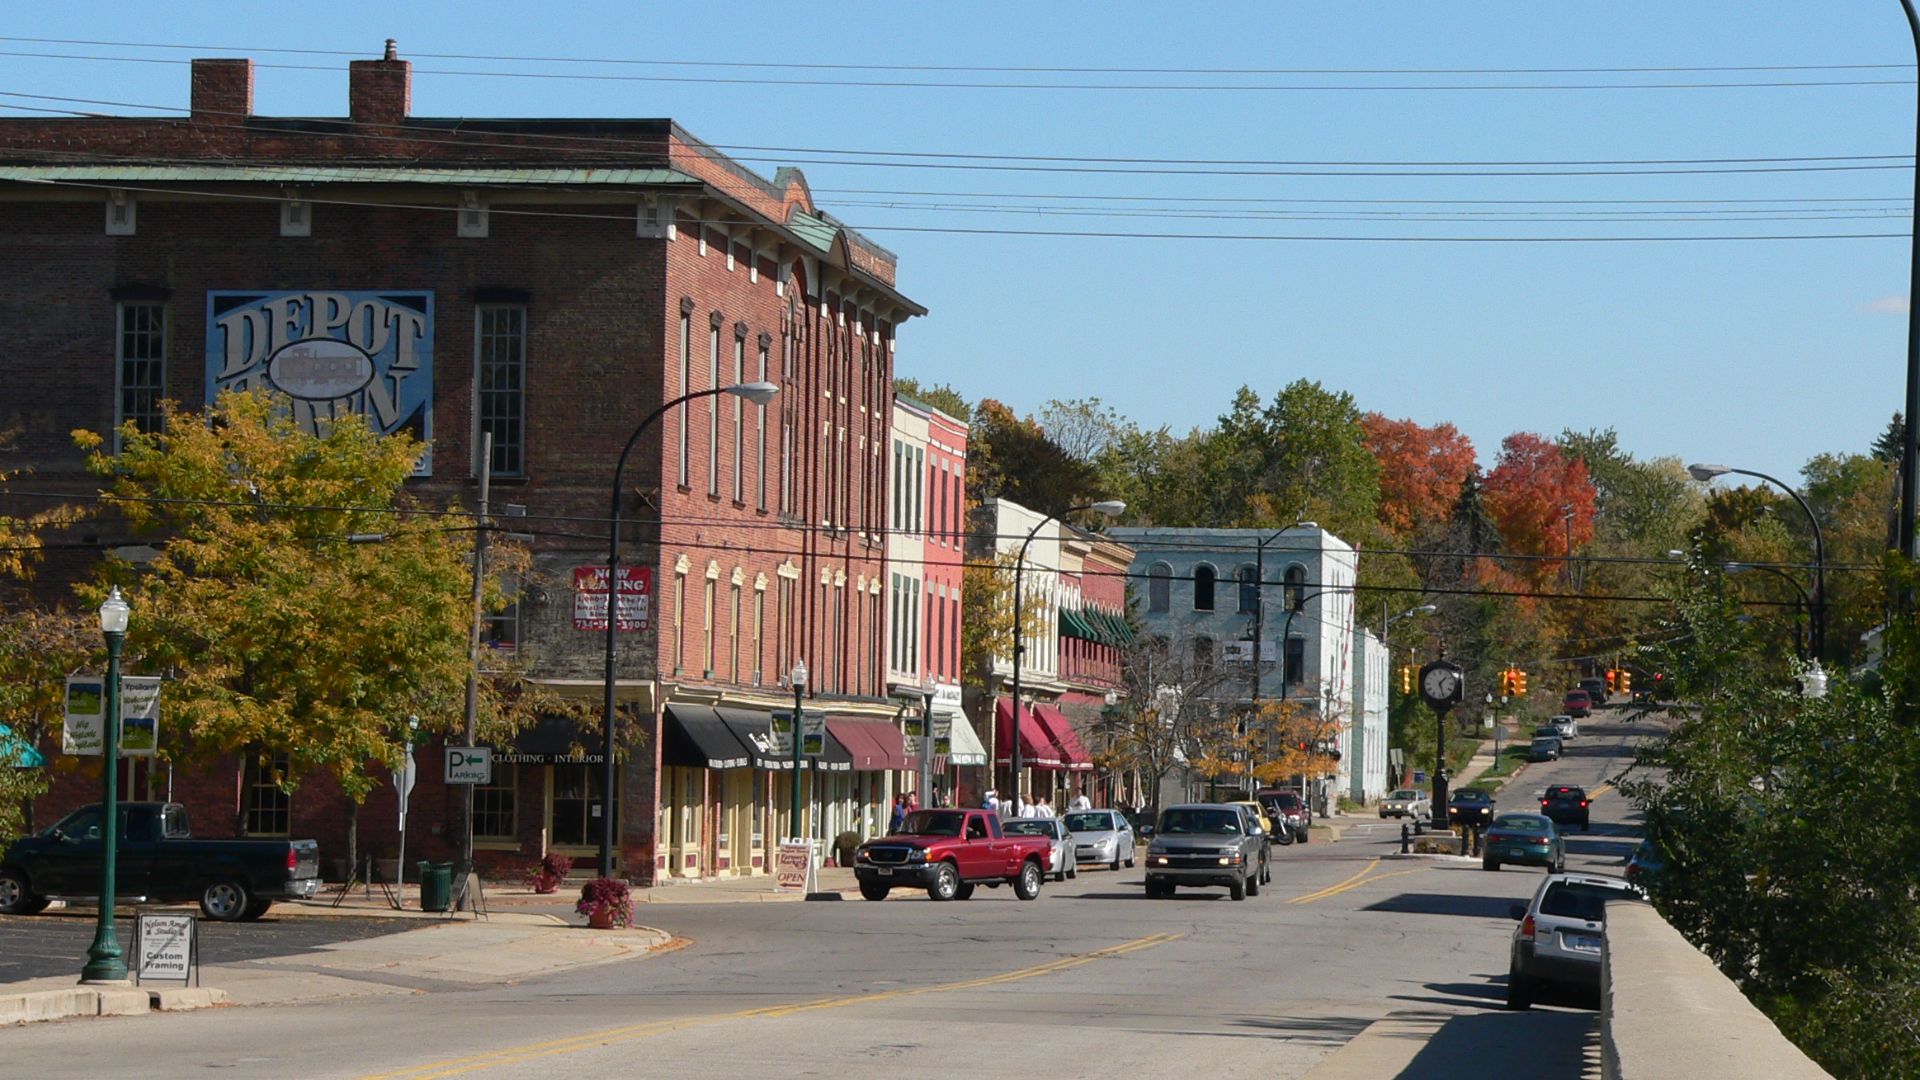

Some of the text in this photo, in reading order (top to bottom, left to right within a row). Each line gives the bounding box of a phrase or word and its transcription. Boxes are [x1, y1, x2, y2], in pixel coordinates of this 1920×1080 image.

[216, 292, 426, 383] DEPOT
[575, 620, 647, 630] 734-3-3900
[491, 754, 545, 764] CLOTHING
[777, 872, 804, 882] OPEN
[146, 951, 183, 960] Custom
[145, 961, 184, 971] Framing
